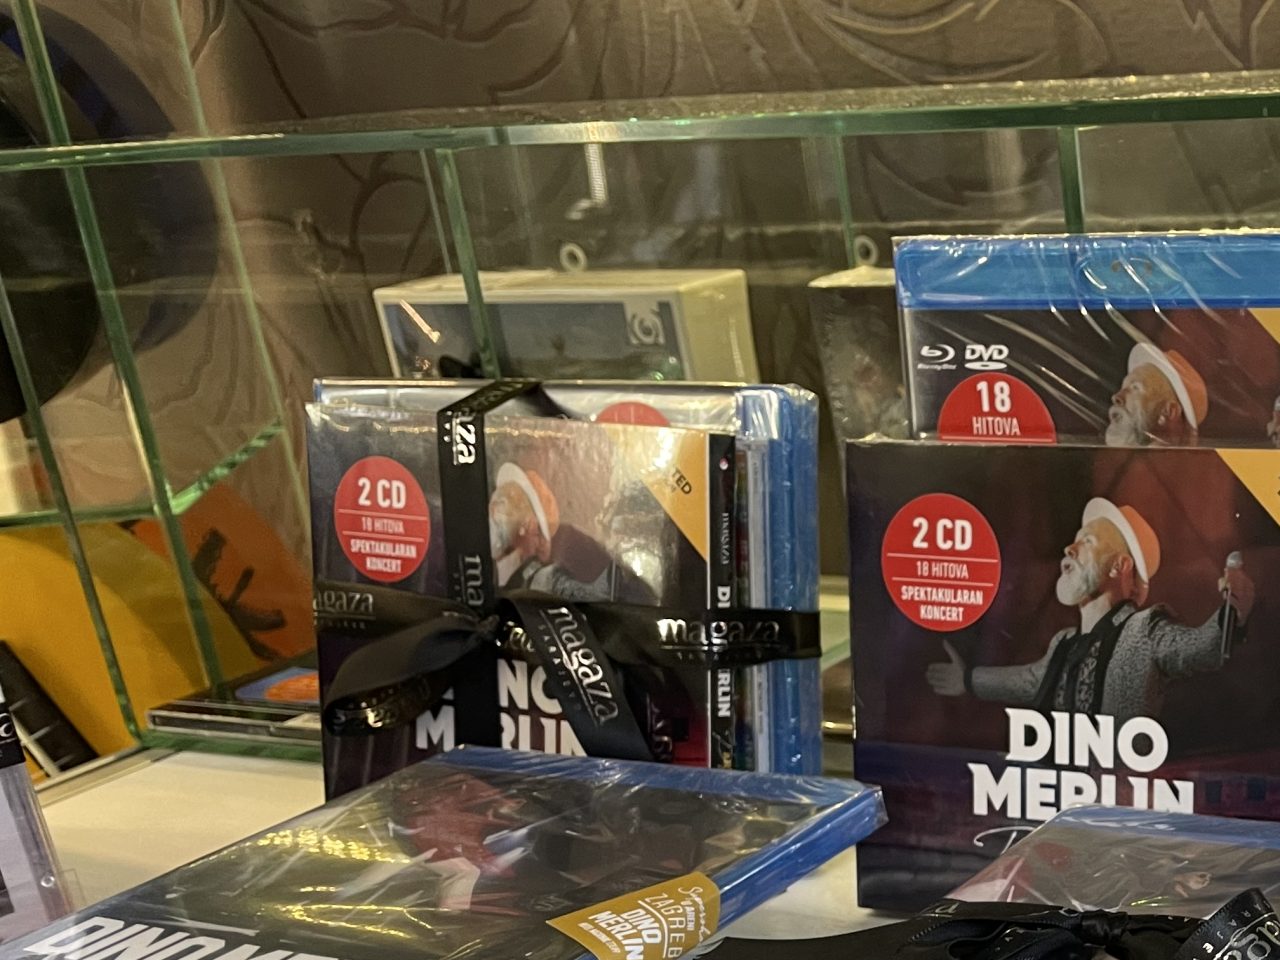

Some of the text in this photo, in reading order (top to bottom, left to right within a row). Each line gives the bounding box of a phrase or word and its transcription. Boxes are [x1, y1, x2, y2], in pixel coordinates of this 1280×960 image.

[965, 344, 1009, 362] DVD
[976, 380, 1012, 413] 18
[972, 416, 1021, 436] HITOVA
[358, 477, 406, 509] 2 CD
[912, 517, 973, 551] 2 CD
[916, 561, 969, 579] 18 HITOVA
[901, 585, 983, 605] SPEKTAKULARAN
[920, 605, 964, 622] KONCERT
[548, 606, 619, 726] magaza
[1003, 707, 1169, 773] DINO
[588, 911, 644, 960] MERLIN
[620, 908, 662, 944] DINO
[645, 892, 685, 958] ZAGREB
